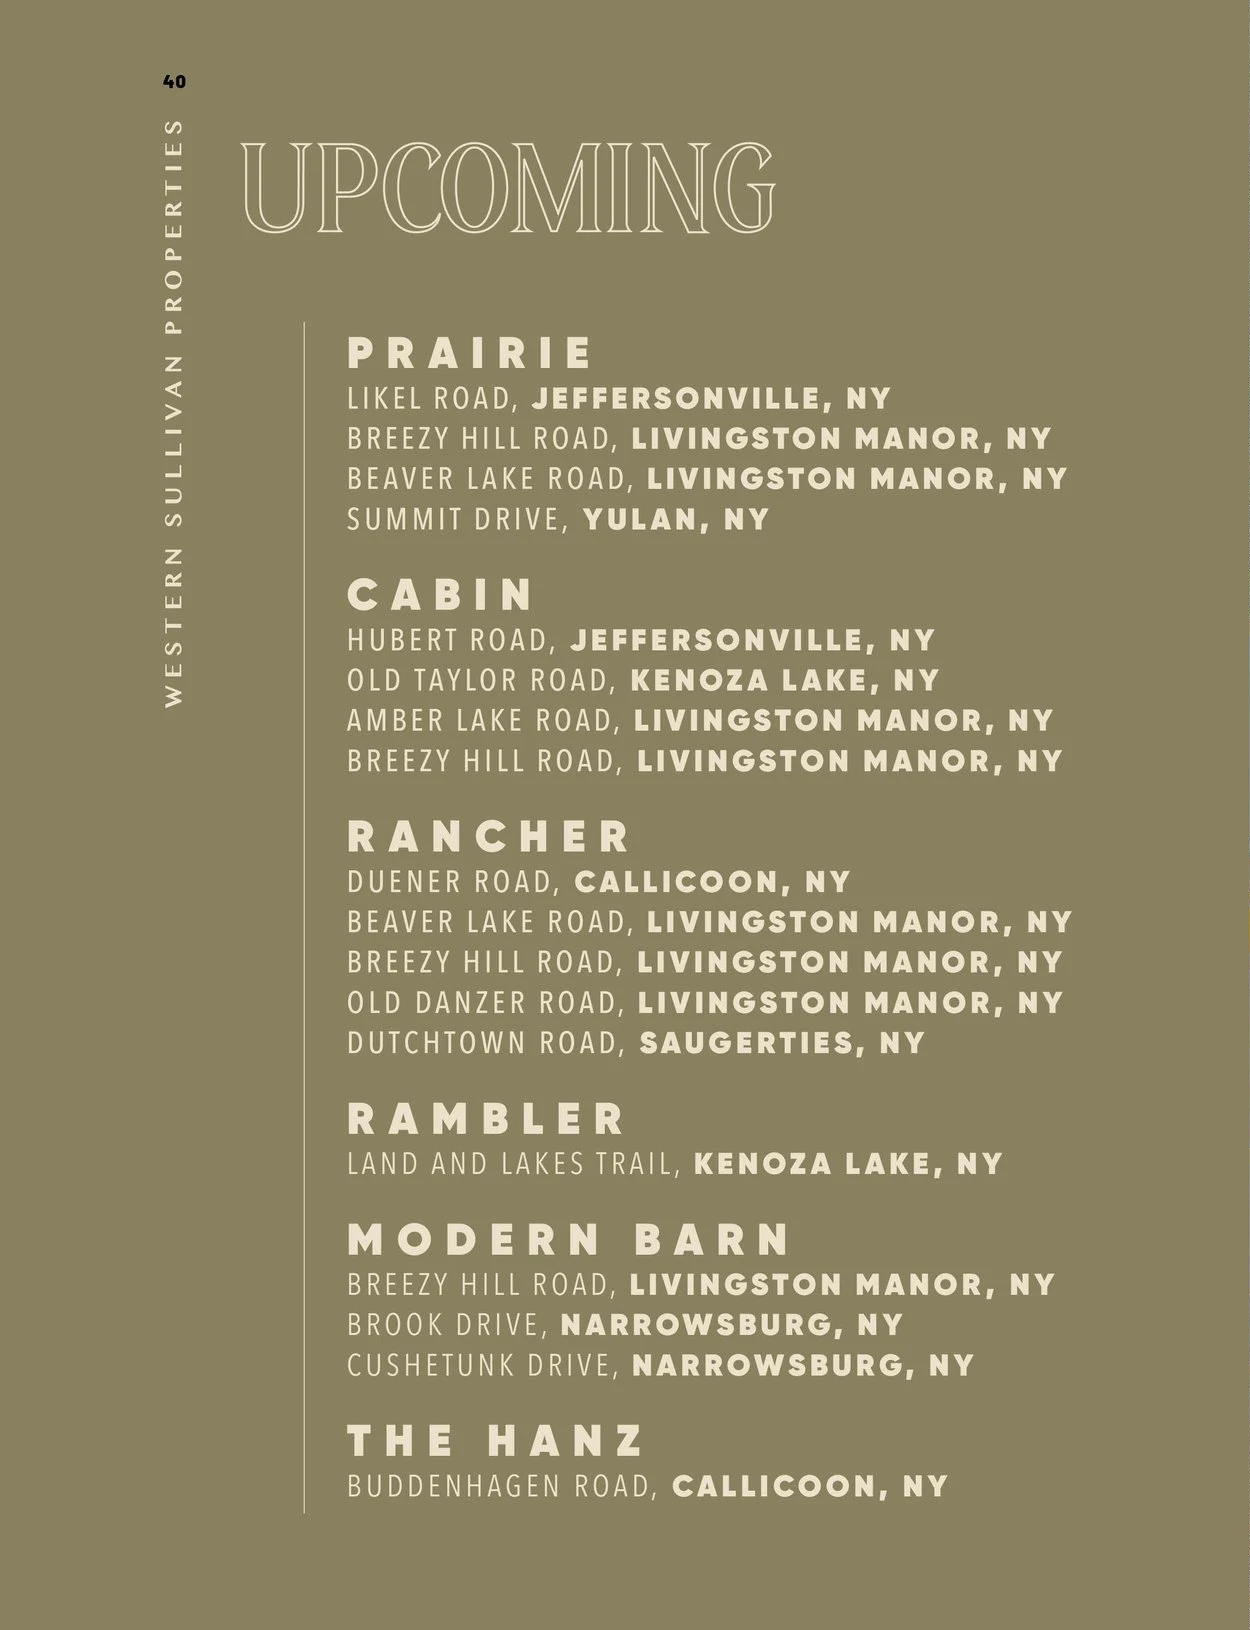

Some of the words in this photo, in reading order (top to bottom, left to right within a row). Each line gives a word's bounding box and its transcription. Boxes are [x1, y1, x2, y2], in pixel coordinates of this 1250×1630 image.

[162, 74, 187, 89] 40
[240, 142, 776, 234] UPCOMING
[164, 120, 183, 335] PROPERTIES
[347, 335, 589, 369] PRAIRIE
[348, 386, 421, 410] LIKEL
[434, 385, 517, 414] ROAD,
[531, 386, 832, 414] JEFFERSONVILLE,
[846, 386, 891, 410] NY
[164, 356, 183, 528] SULLIVAN
[348, 426, 449, 450] BREEZY
[462, 426, 521, 450] HILL
[534, 425, 617, 454] ROAD,
[632, 426, 840, 451] LIVINGSTON
[855, 426, 992, 454] MANOR,
[1006, 426, 1052, 450] NY
[348, 466, 453, 490] BEAVER
[467, 466, 533, 490] LAKE
[548, 465, 633, 494] ROAD,
[647, 466, 855, 491] LIVINGSTON
[870, 466, 1007, 494] MANOR,
[1022, 466, 1068, 490] NY
[346, 506, 462, 531] SUMMIT
[475, 506, 568, 535] DRIVE,
[582, 507, 709, 535] YULAN,
[724, 507, 769, 531] NY
[346, 577, 530, 612] CABIN
[164, 548, 183, 709] WESTERN
[348, 627, 457, 652] HUBERT
[471, 627, 555, 656] ROAD,
[569, 627, 875, 656] JEFFERSONVILLE,
[890, 628, 936, 652] NY
[347, 667, 401, 692] OLD
[413, 667, 516, 692] TAYLOR
[531, 667, 615, 696] ROAD,
[631, 667, 769, 692] KENOZA
[782, 668, 879, 696] LAKE,
[894, 668, 940, 692] NY
[346, 708, 442, 732] AMBER
[457, 707, 522, 732] LAKE
[536, 707, 620, 736] ROAD,
[634, 708, 842, 732] LIVINGSTON
[857, 708, 994, 736] MANOR,
[1008, 708, 1054, 732] NY
[348, 748, 450, 773] BREEZY
[464, 748, 524, 773] HILL
[538, 748, 622, 777] ROAD,
[637, 748, 849, 773] LIVINGSTON
[863, 748, 1003, 777] MANOR,
[1017, 749, 1063, 773] NY
[347, 819, 628, 854] RANCHER
[348, 869, 460, 894] DUENER
[475, 869, 559, 897] ROAD,
[574, 869, 790, 898] CALLICOON,
[805, 870, 851, 893] NY
[348, 909, 453, 934] BEAVER
[467, 909, 533, 934] LAKE
[548, 909, 633, 937] ROAD,
[647, 909, 858, 934] LIVINGSTON
[873, 909, 1012, 938] MANOR,
[1027, 910, 1073, 934] NY
[348, 949, 450, 974] BREEZY
[464, 949, 525, 974] HILL
[538, 949, 622, 977] ROAD,
[637, 949, 849, 974] LIVINGSTON
[863, 950, 1003, 978] MANOR,
[1017, 950, 1063, 974] NY
[347, 990, 401, 1015] OLD
[416, 990, 525, 1014] DANZER
[540, 990, 624, 1018] ROAD,
[638, 990, 849, 1015] LIVINGSTON
[864, 990, 1003, 1018] MANOR,
[1018, 990, 1064, 1014] NY
[348, 1030, 524, 1055] DUTCHTOWN
[540, 1030, 624, 1058] ROAD,
[639, 1030, 865, 1059] SAUGERTIES,
[880, 1031, 925, 1054] NY
[347, 1101, 622, 1135] RAMBLER
[348, 1151, 417, 1175] LAND
[431, 1151, 487, 1175] AND
[502, 1151, 583, 1176] LAKES
[595, 1151, 680, 1179] TRAIL,
[694, 1151, 832, 1176] KENOZA
[845, 1151, 943, 1180] LAKE,
[957, 1151, 1003, 1175] NY
[347, 1222, 597, 1257] MODERN
[635, 1222, 786, 1256] BARN
[348, 1272, 448, 1296] BREEZY
[461, 1272, 520, 1296] HILL
[533, 1271, 616, 1300] ROAD,
[630, 1272, 841, 1297] LIVINGSTON
[855, 1272, 995, 1300] MANOR,
[1010, 1272, 1055, 1296] NY
[348, 1311, 443, 1337] BROOK
[457, 1312, 547, 1340] DRIVE,
[561, 1312, 843, 1341] NARROWSBURG,
[857, 1312, 903, 1336] NY
[347, 1352, 514, 1377] CUSHETUNK
[528, 1352, 618, 1381] DRIVE,
[632, 1353, 914, 1381] NARROWSBURG,
[929, 1353, 974, 1377] NY
[346, 1423, 451, 1457] THE
[488, 1423, 641, 1457] HANZ
[348, 1473, 558, 1498] BUDDENHAGEN
[575, 1473, 657, 1502] ROAD,
[671, 1473, 888, 1502] CALLICOON,
[903, 1474, 949, 1498] NY
